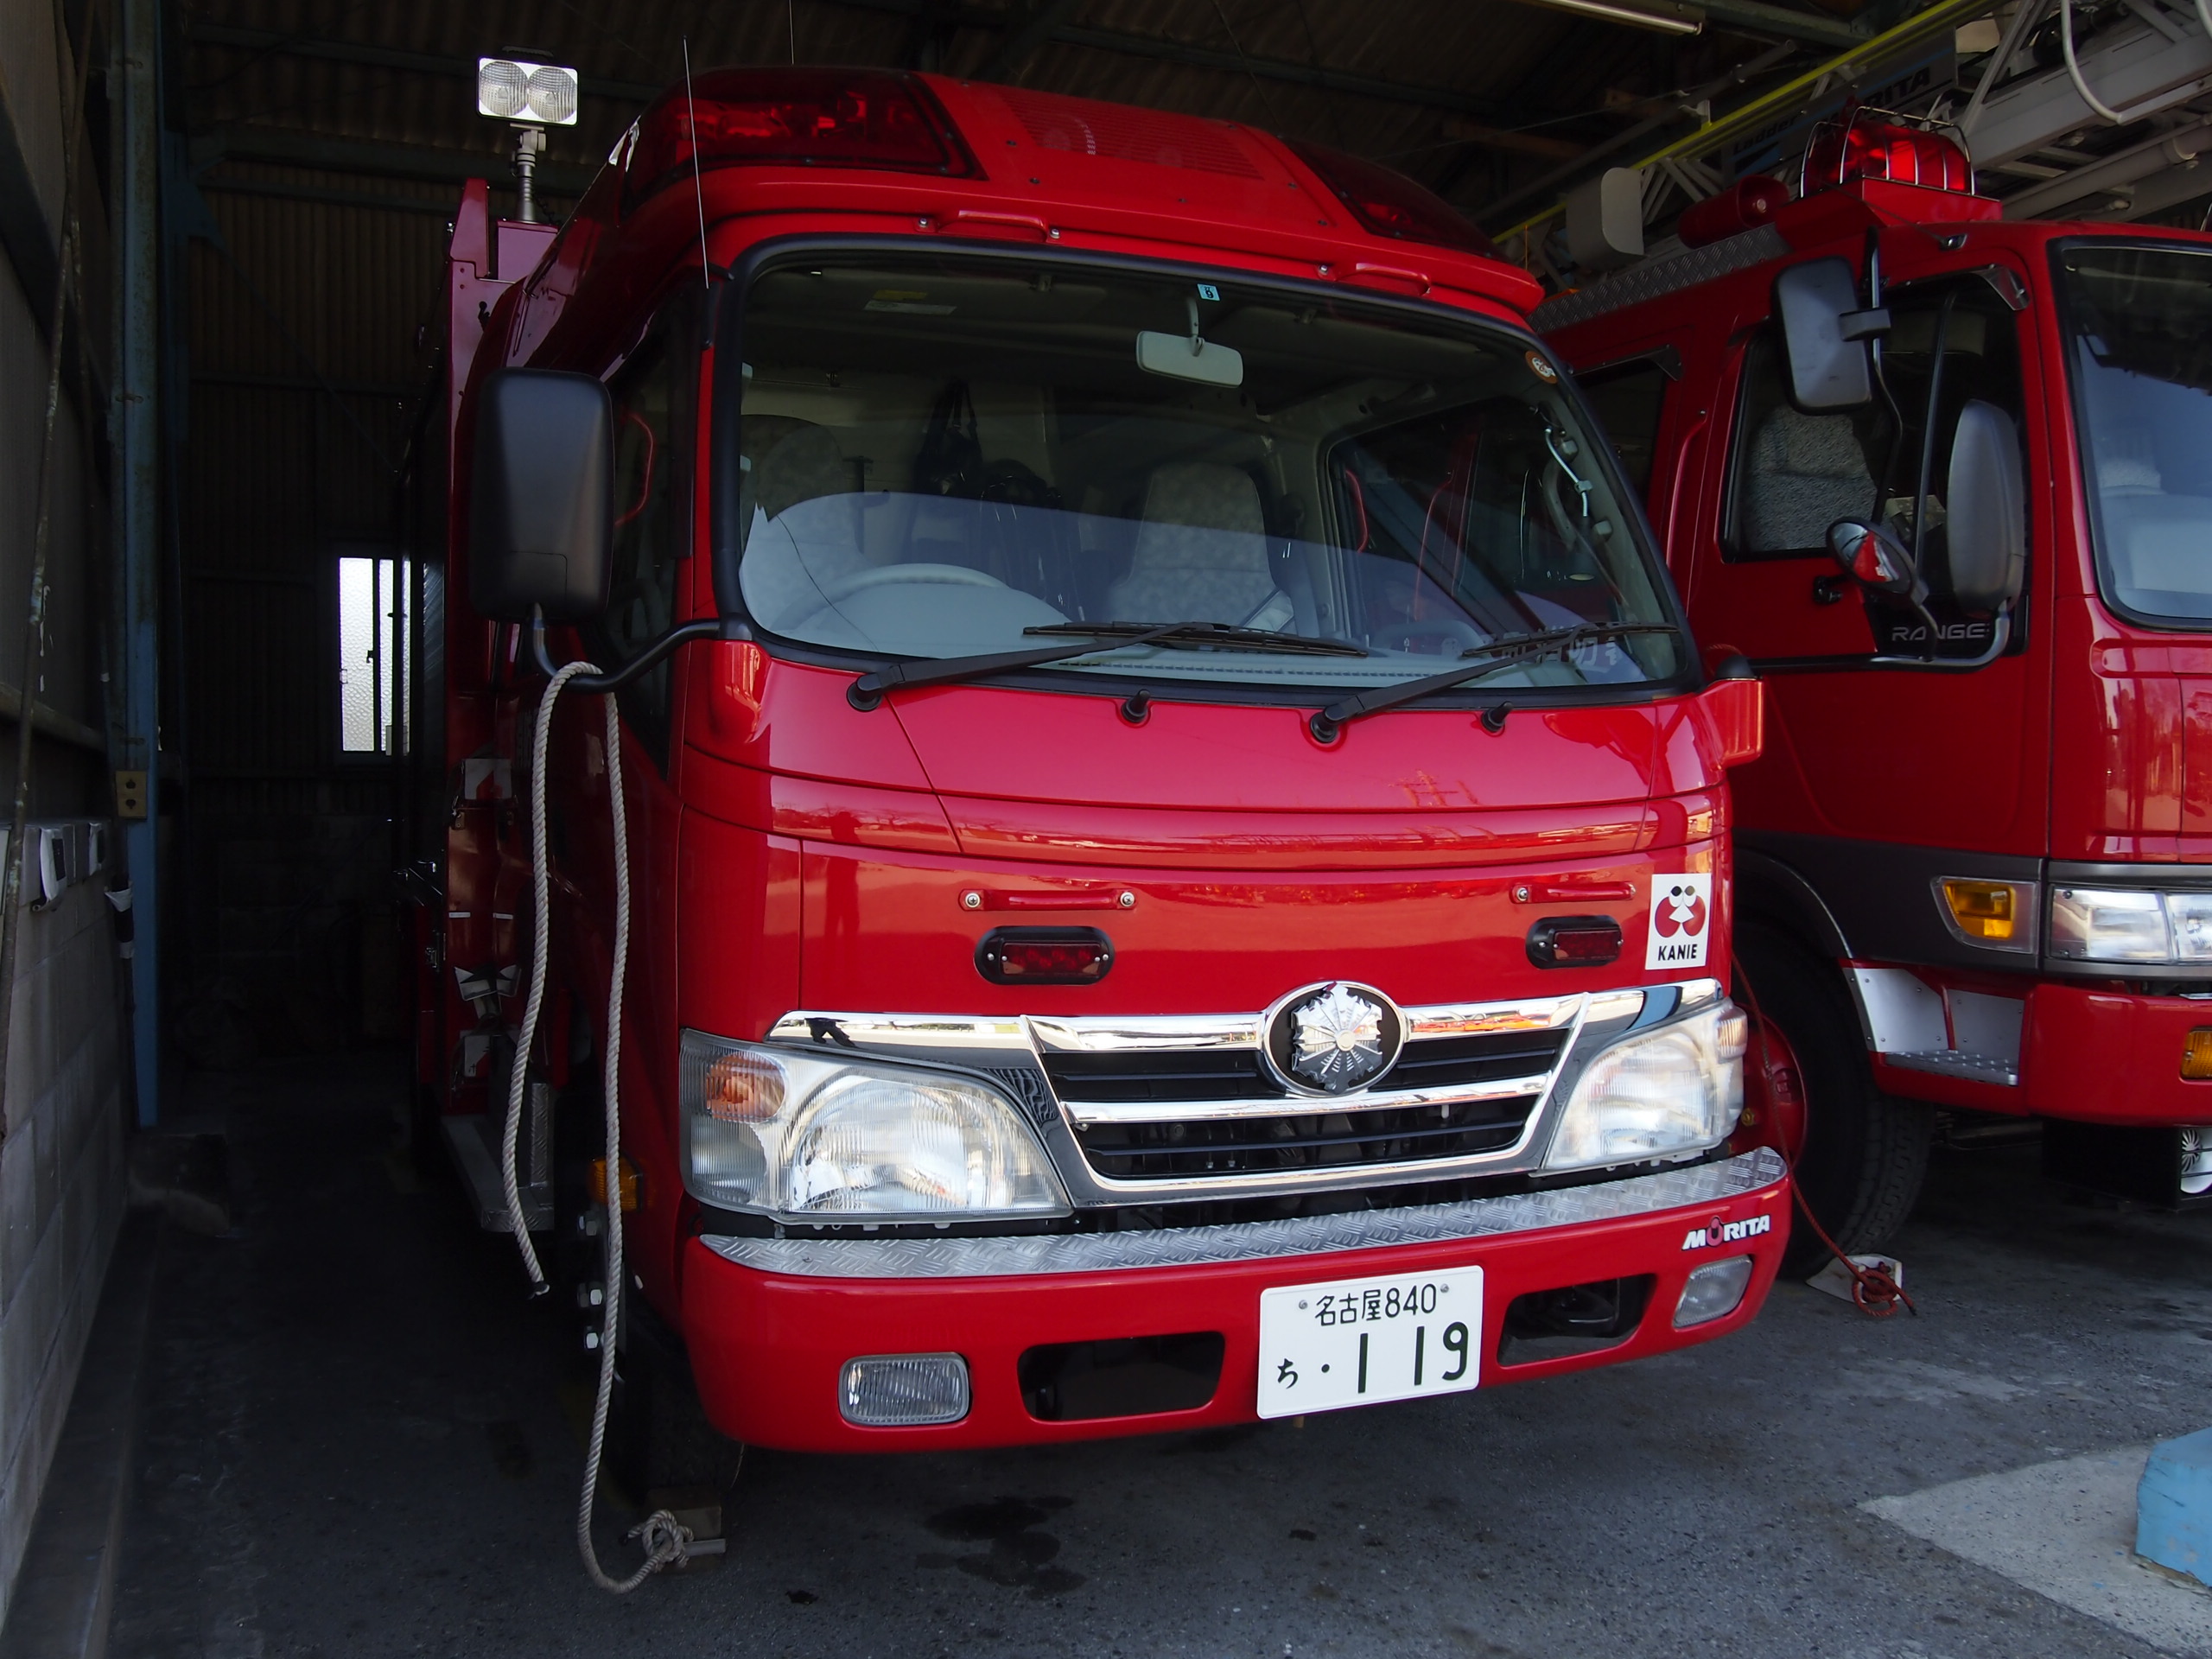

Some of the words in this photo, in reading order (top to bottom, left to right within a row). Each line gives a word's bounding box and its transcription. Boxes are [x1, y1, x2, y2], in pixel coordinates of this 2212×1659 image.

[1734, 115, 1798, 153] Ladder
[1891, 623, 1990, 641] RANGE
[1658, 944, 1698, 961] KANIE
[1681, 1214, 1770, 1250] MORITA
[1315, 1283, 1437, 1326] 名古屋840
